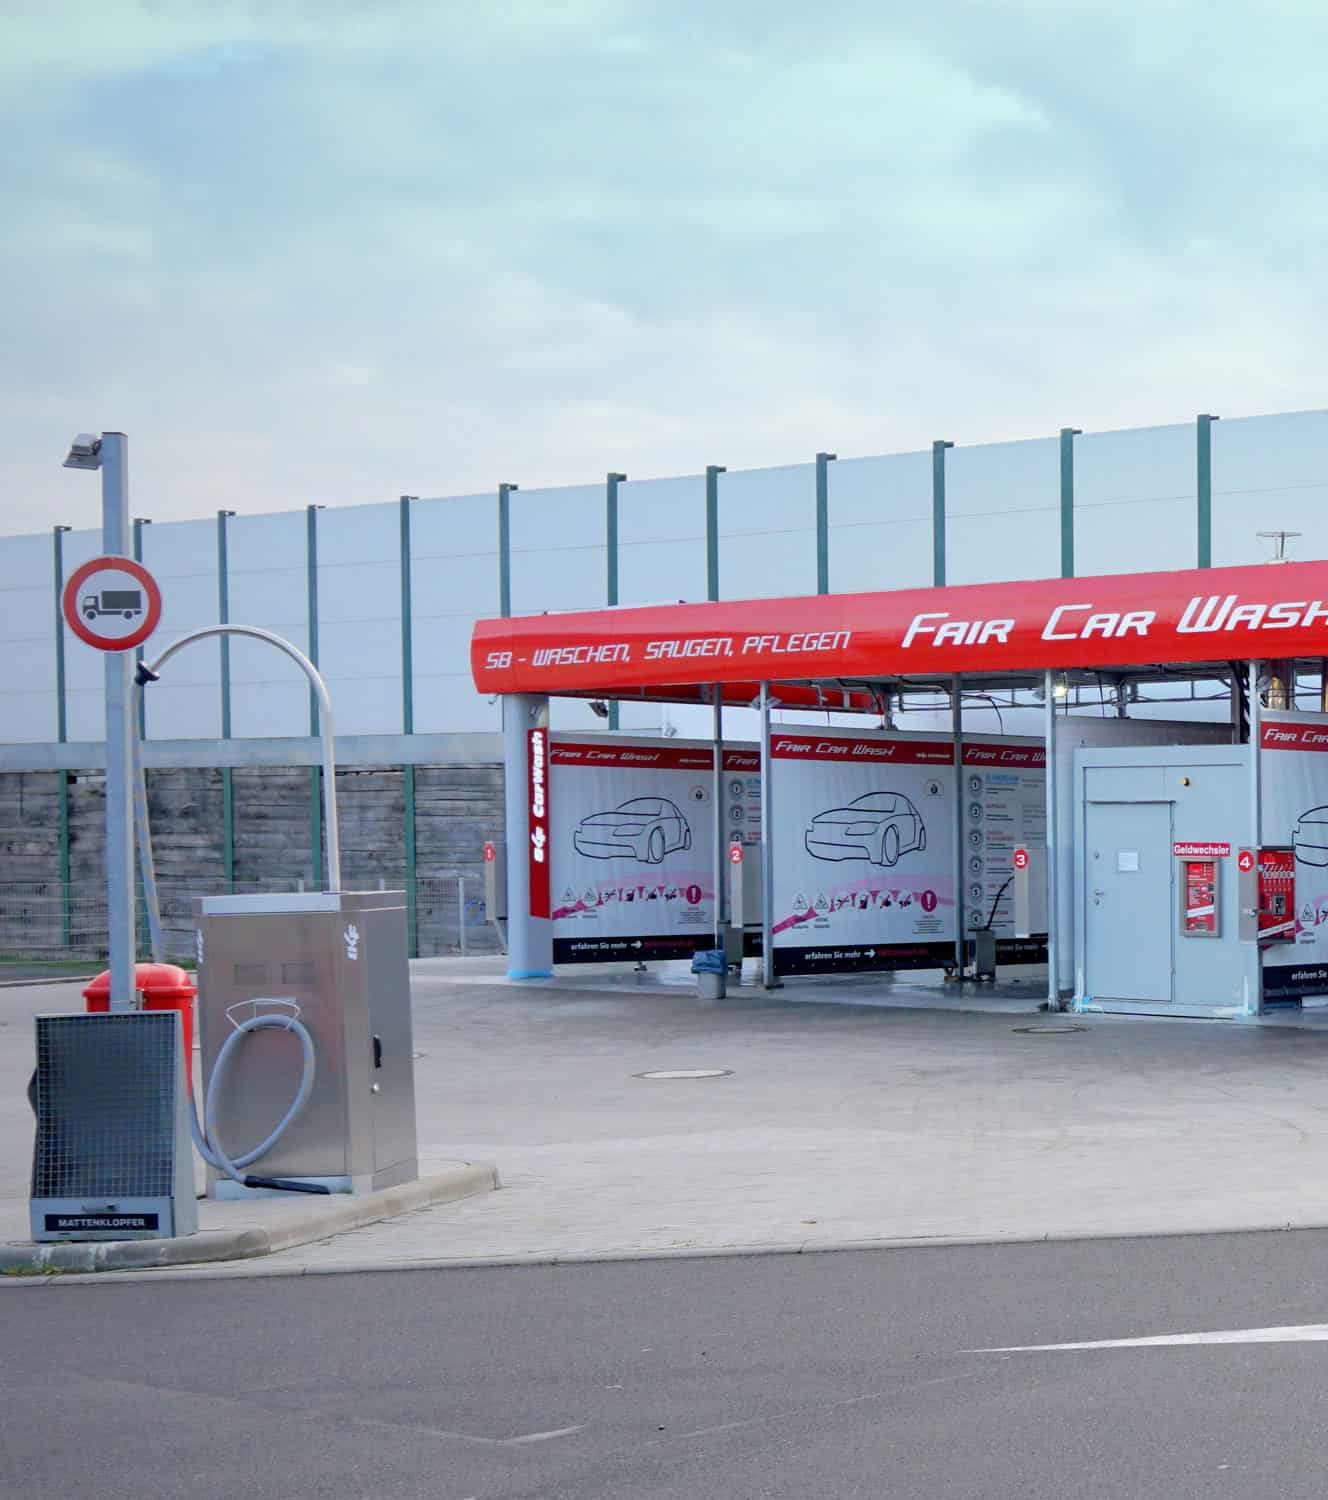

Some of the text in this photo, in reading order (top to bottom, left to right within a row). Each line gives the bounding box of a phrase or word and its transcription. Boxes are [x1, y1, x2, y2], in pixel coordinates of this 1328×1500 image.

[485, 652, 512, 669] SB
[532, 644, 631, 666] WASCHEN,
[644, 638, 732, 661] SAUGEN,
[742, 630, 851, 655] PFLEGEN
[487, 848, 492, 858] 1
[732, 850, 741, 861] 2
[1016, 854, 1025, 865] 3
[1240, 856, 1251, 868] 4
[58, 1218, 145, 1227] MATTENKLOPFER
